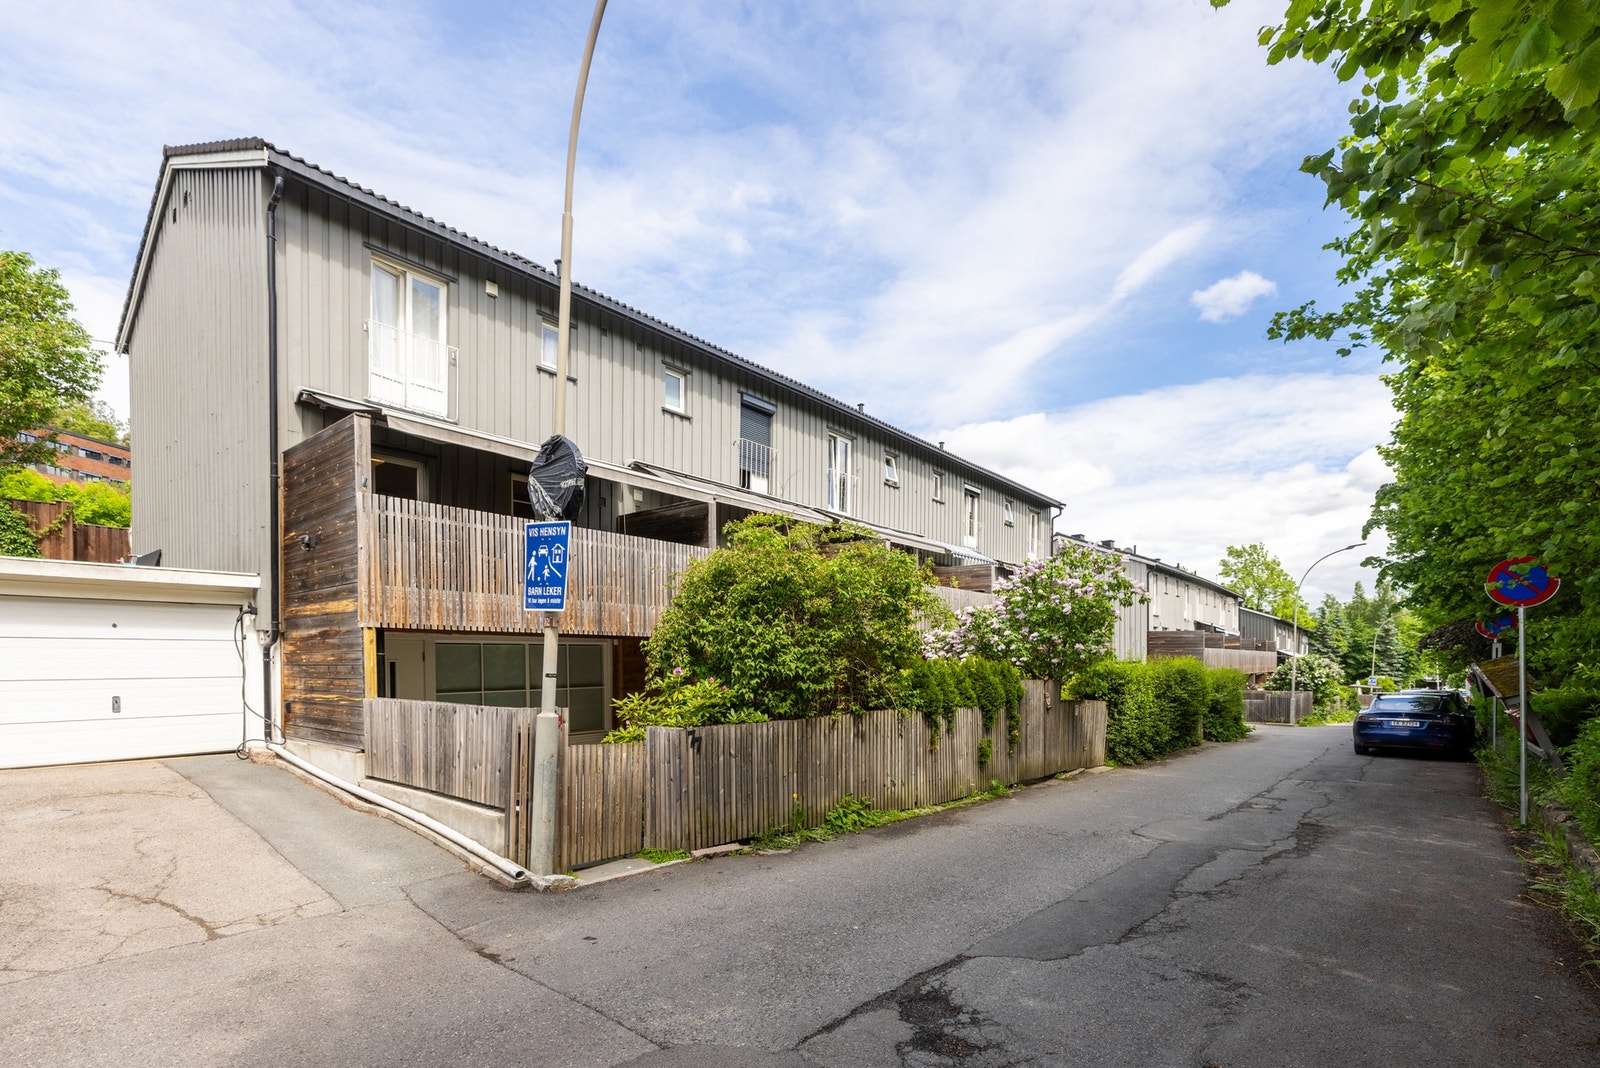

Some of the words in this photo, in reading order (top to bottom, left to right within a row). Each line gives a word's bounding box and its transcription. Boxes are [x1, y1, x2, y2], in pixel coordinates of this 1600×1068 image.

[529, 528, 539, 537] VIS
[540, 526, 566, 537] HENSYN
[528, 587, 542, 596] BARN
[543, 587, 562, 596] LEKER
